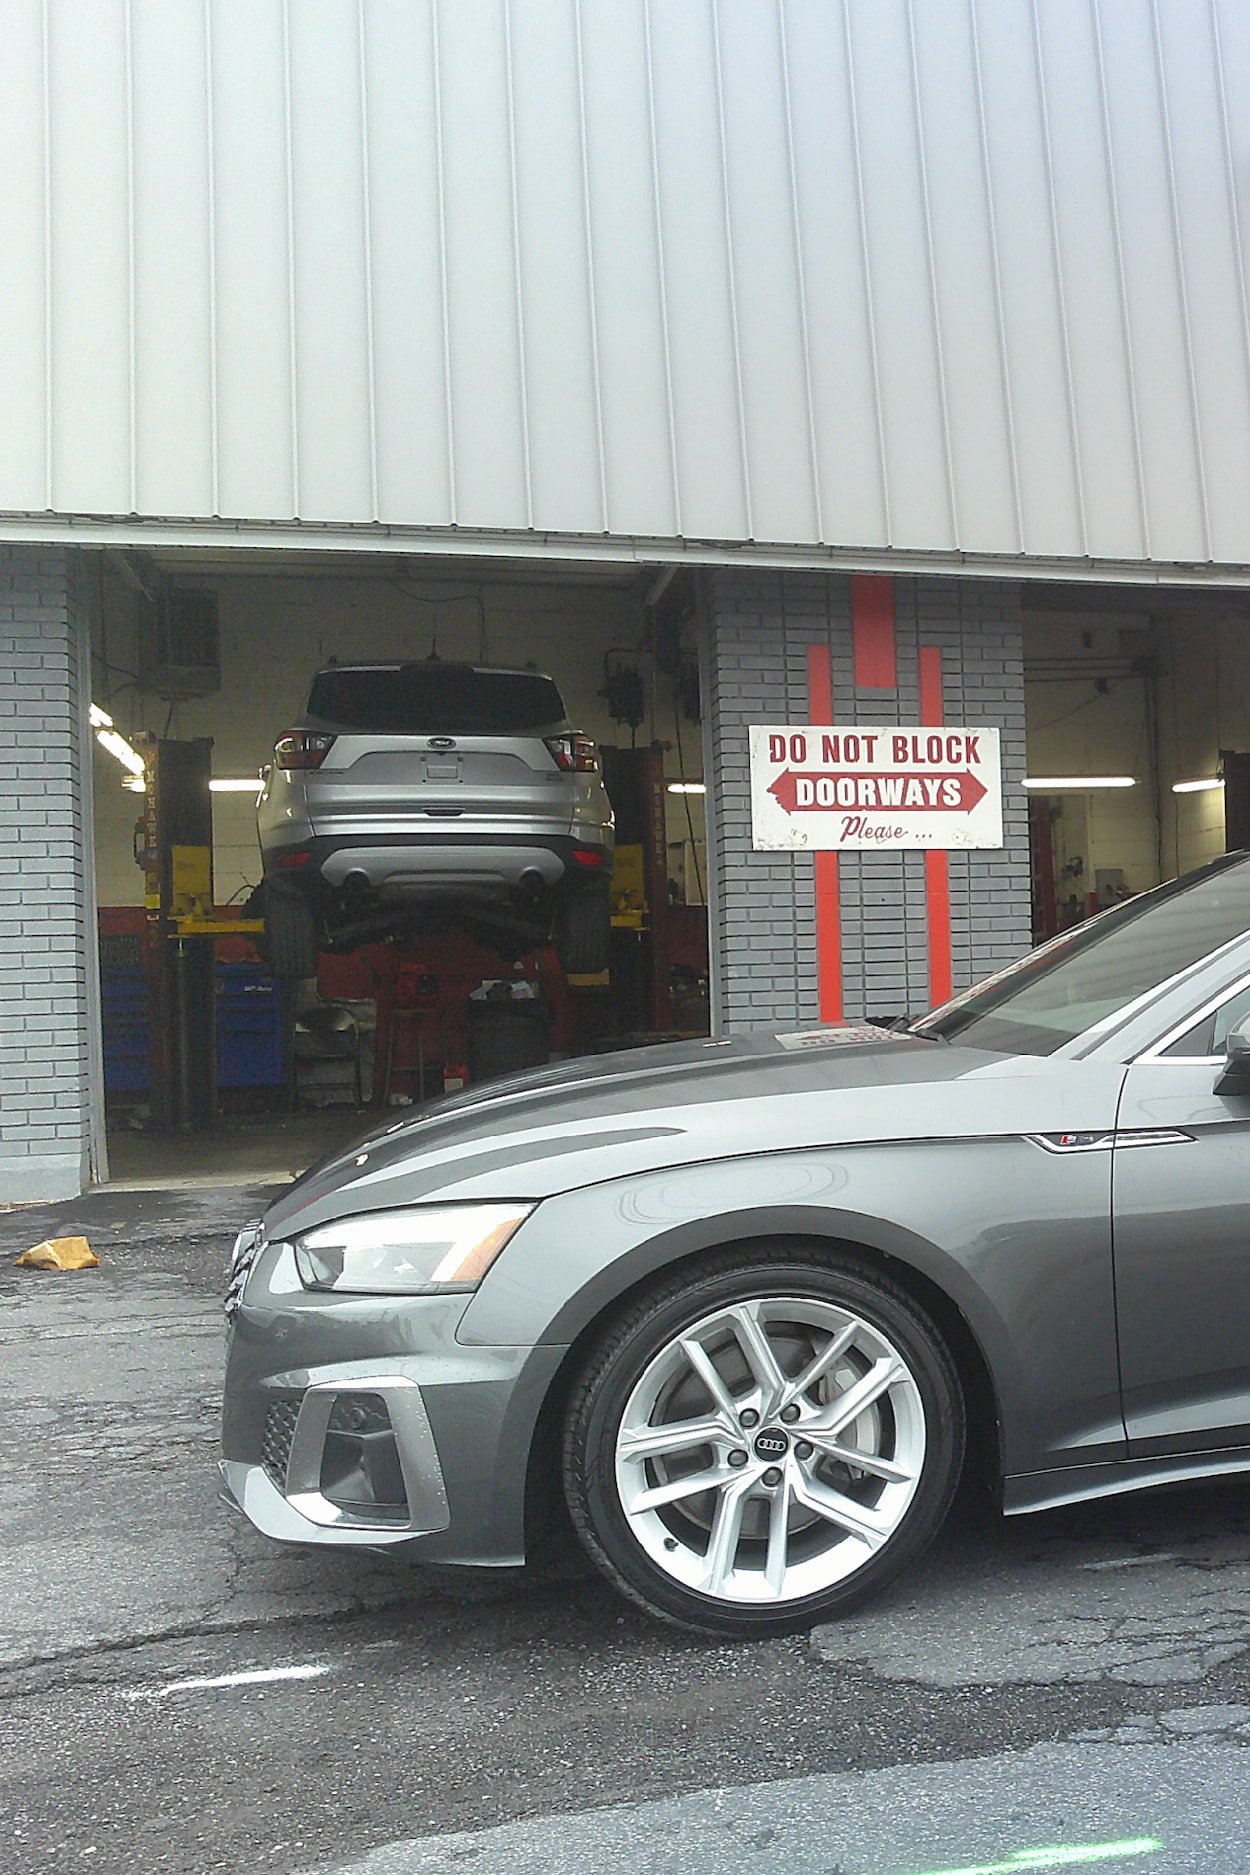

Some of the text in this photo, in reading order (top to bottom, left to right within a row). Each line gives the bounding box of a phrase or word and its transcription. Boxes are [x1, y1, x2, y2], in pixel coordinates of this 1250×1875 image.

[769, 734, 981, 764] DO NOT BLOCK
[796, 777, 962, 807] DOORWAYS
[840, 816, 908, 843] Please
